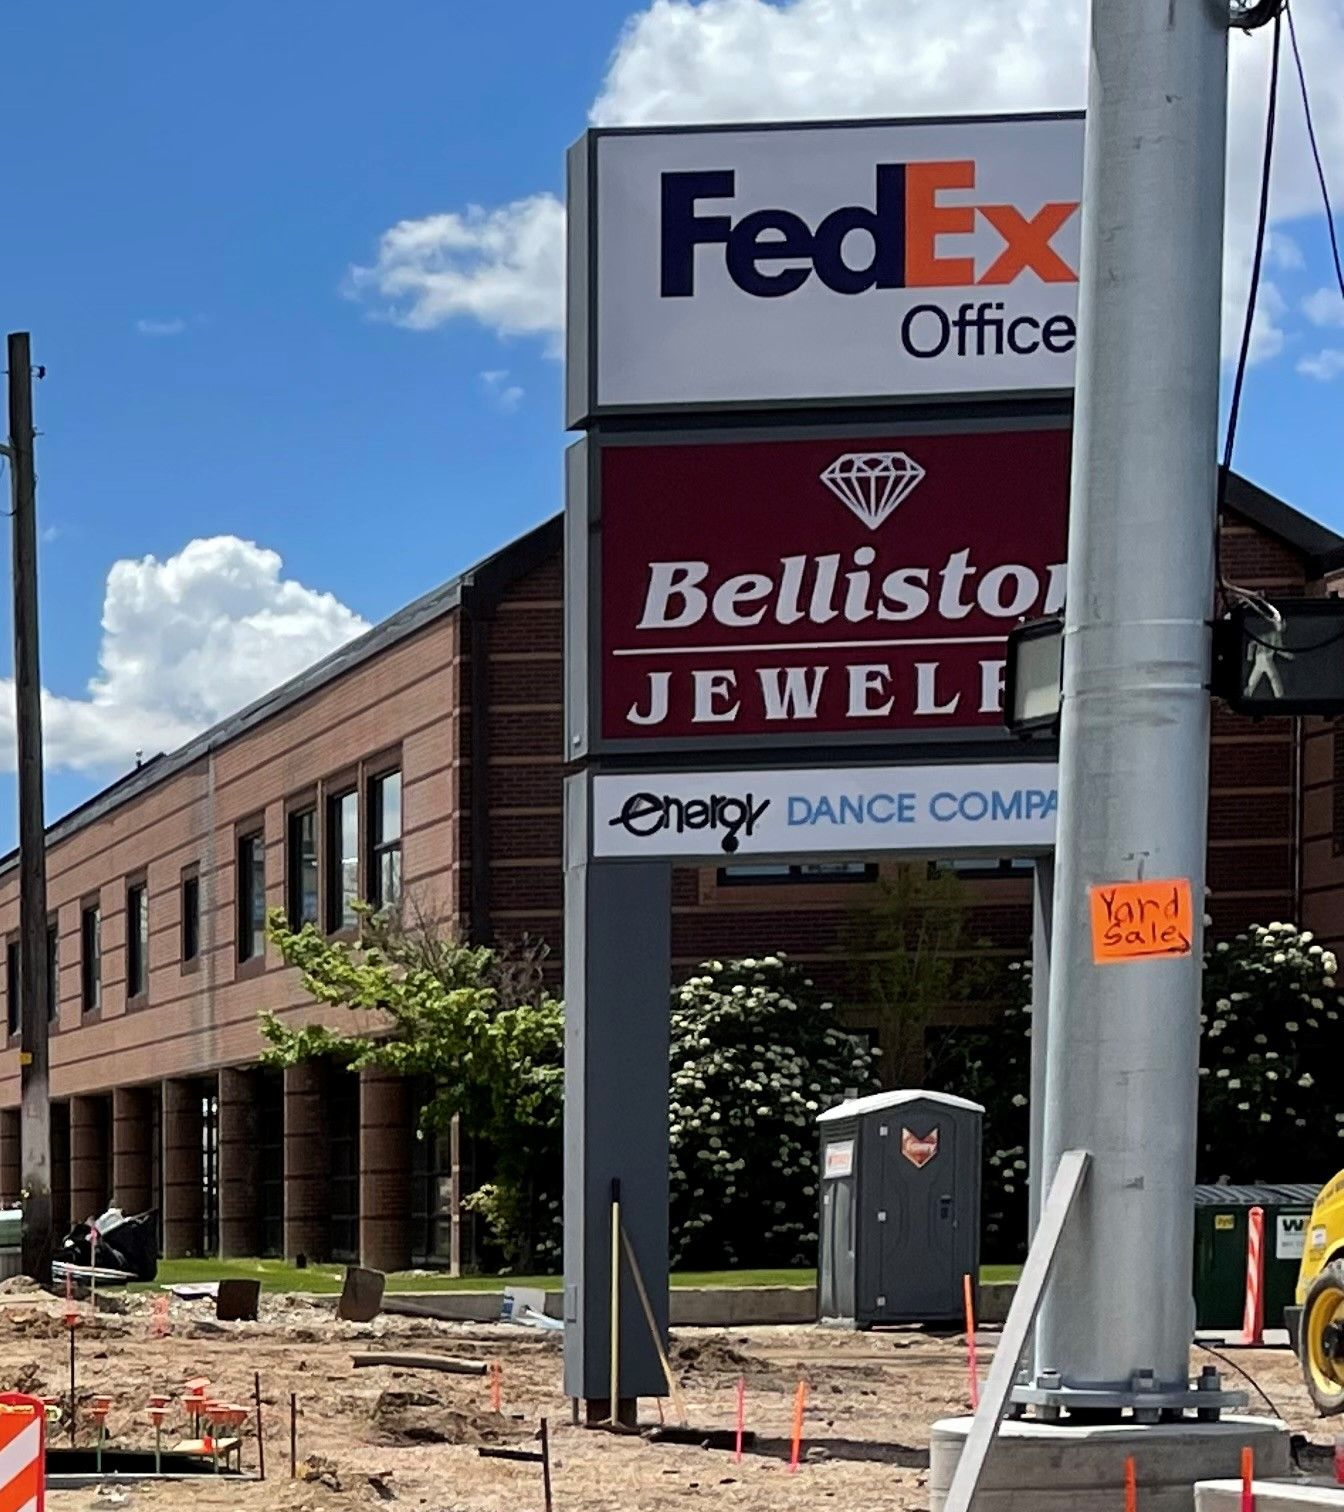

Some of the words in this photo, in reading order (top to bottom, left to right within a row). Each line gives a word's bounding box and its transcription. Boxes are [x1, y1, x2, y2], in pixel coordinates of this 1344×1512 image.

[661, 159, 1081, 298] FedEx
[900, 302, 1077, 359] Office
[608, 791, 771, 854] energy
[787, 792, 916, 827] DANCE
[1099, 886, 1179, 924] Yard
